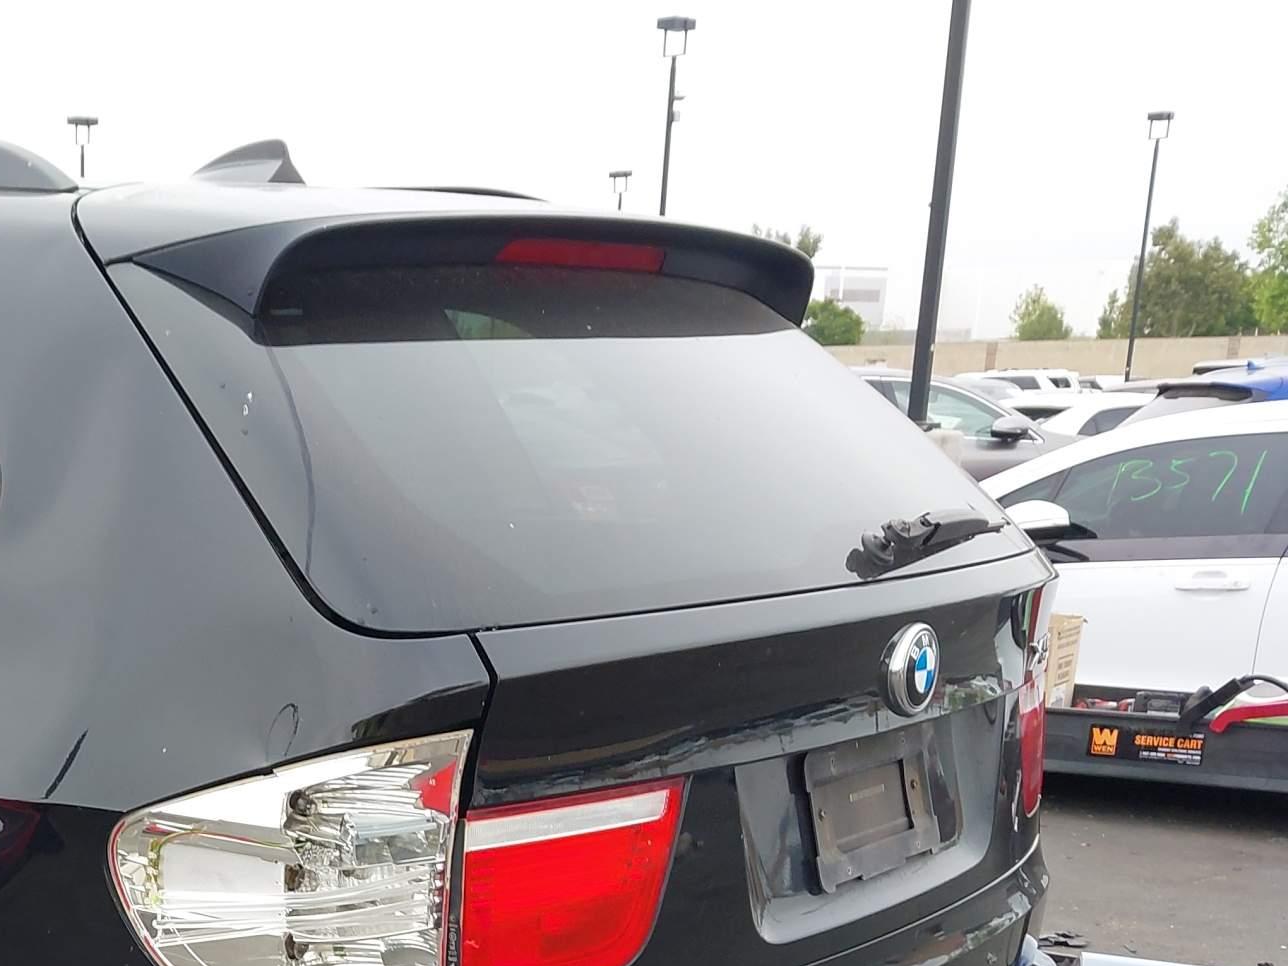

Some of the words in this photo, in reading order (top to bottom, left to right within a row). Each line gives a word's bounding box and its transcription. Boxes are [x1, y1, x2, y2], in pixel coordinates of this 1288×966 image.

[1135, 735, 1174, 747] SERVICE
[1177, 739, 1203, 749] CART
[1093, 745, 1114, 753] WEN
